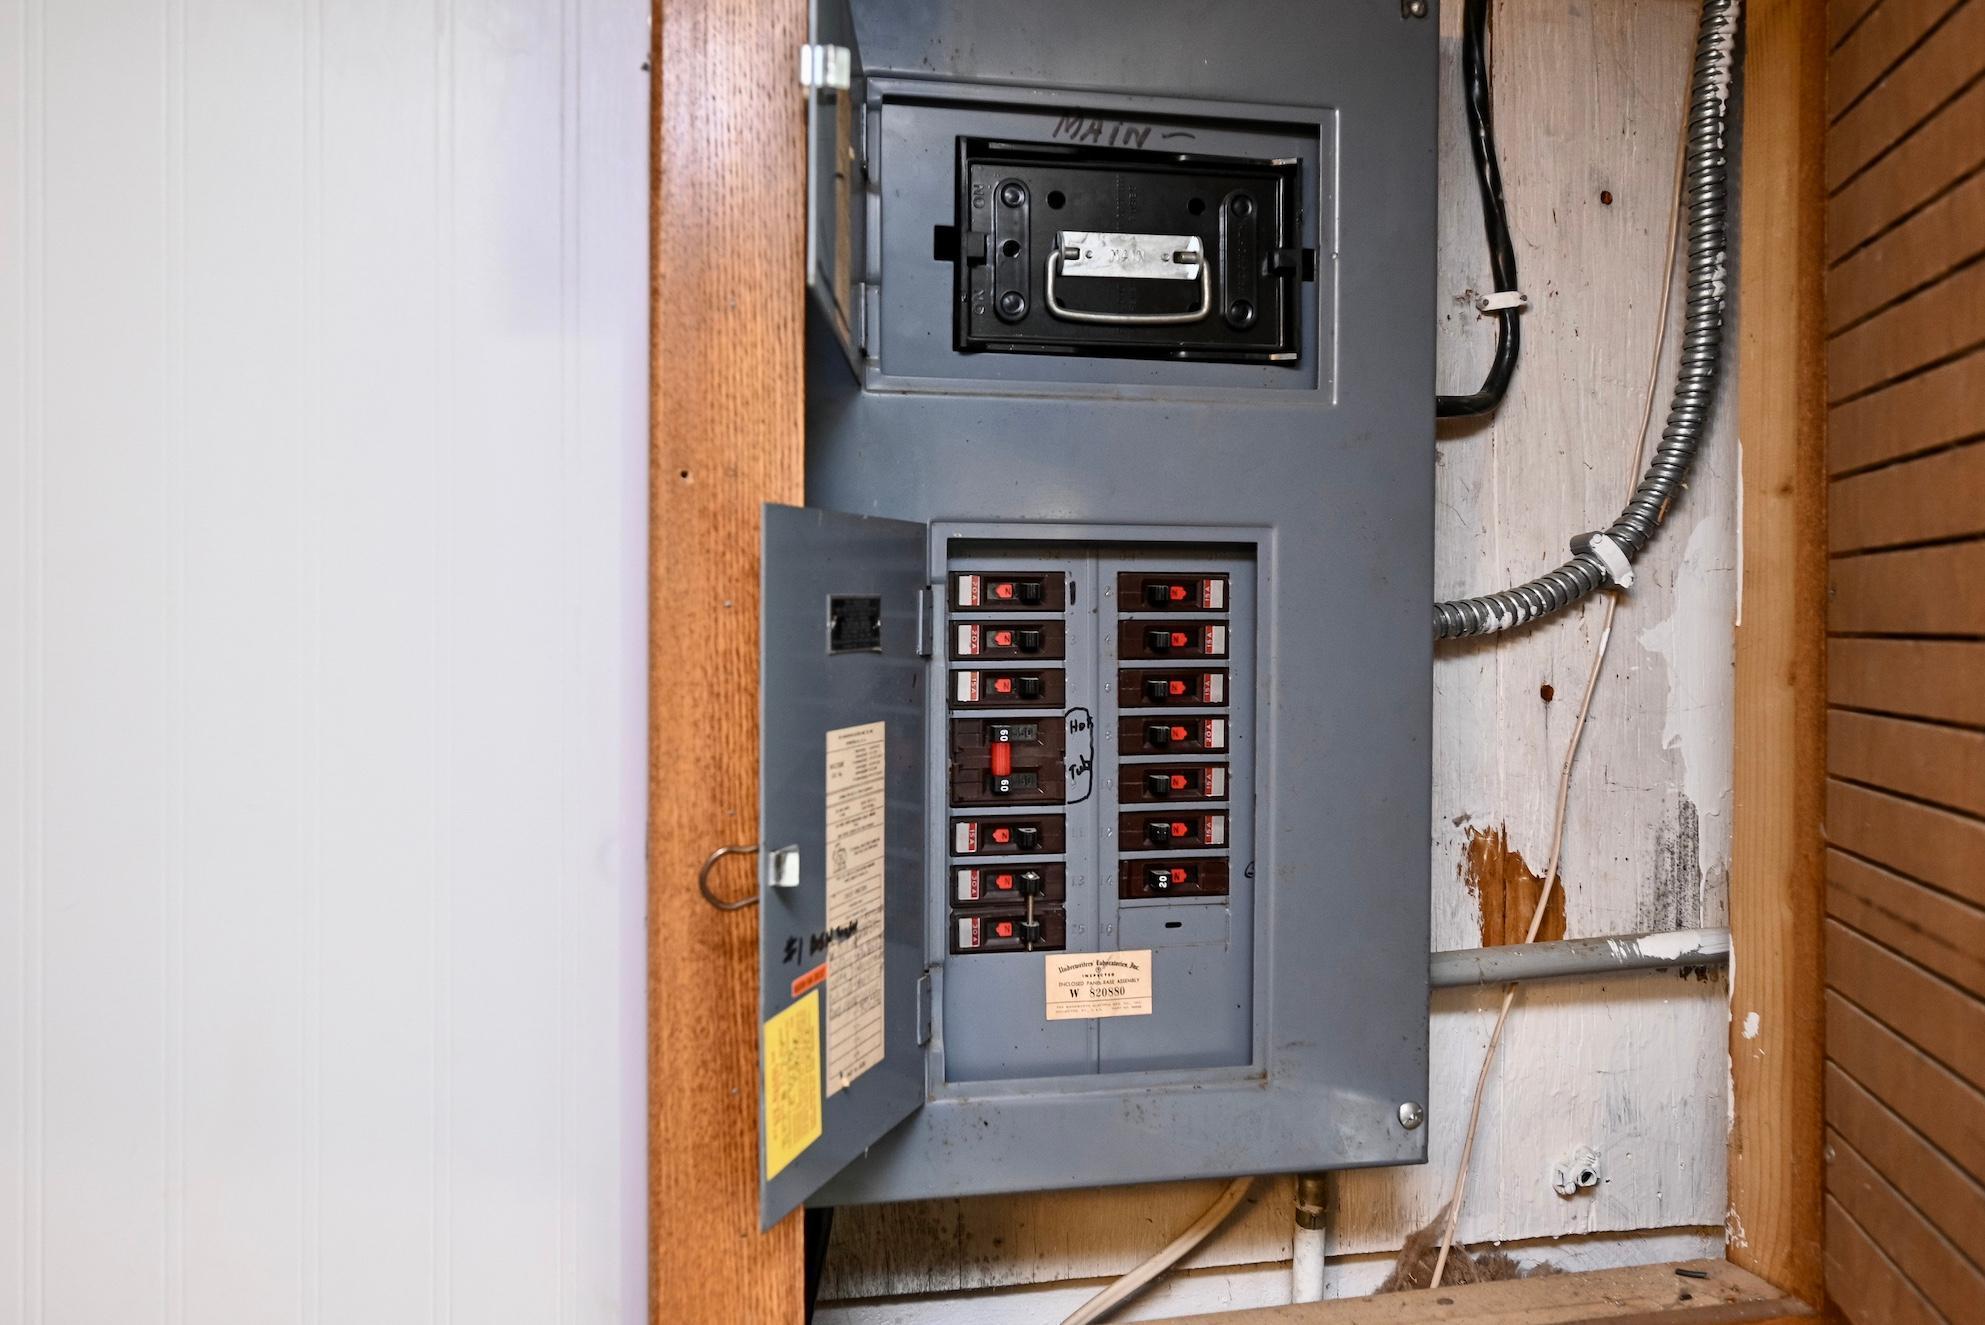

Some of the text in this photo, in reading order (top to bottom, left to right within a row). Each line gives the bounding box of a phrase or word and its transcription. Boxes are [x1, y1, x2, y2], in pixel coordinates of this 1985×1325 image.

[1052, 114, 1152, 148] MAIN
[1000, 729, 1009, 742] 60
[1000, 779, 1010, 792] 60
[1159, 875, 1167, 888] 20
[1069, 988, 1080, 999] W
